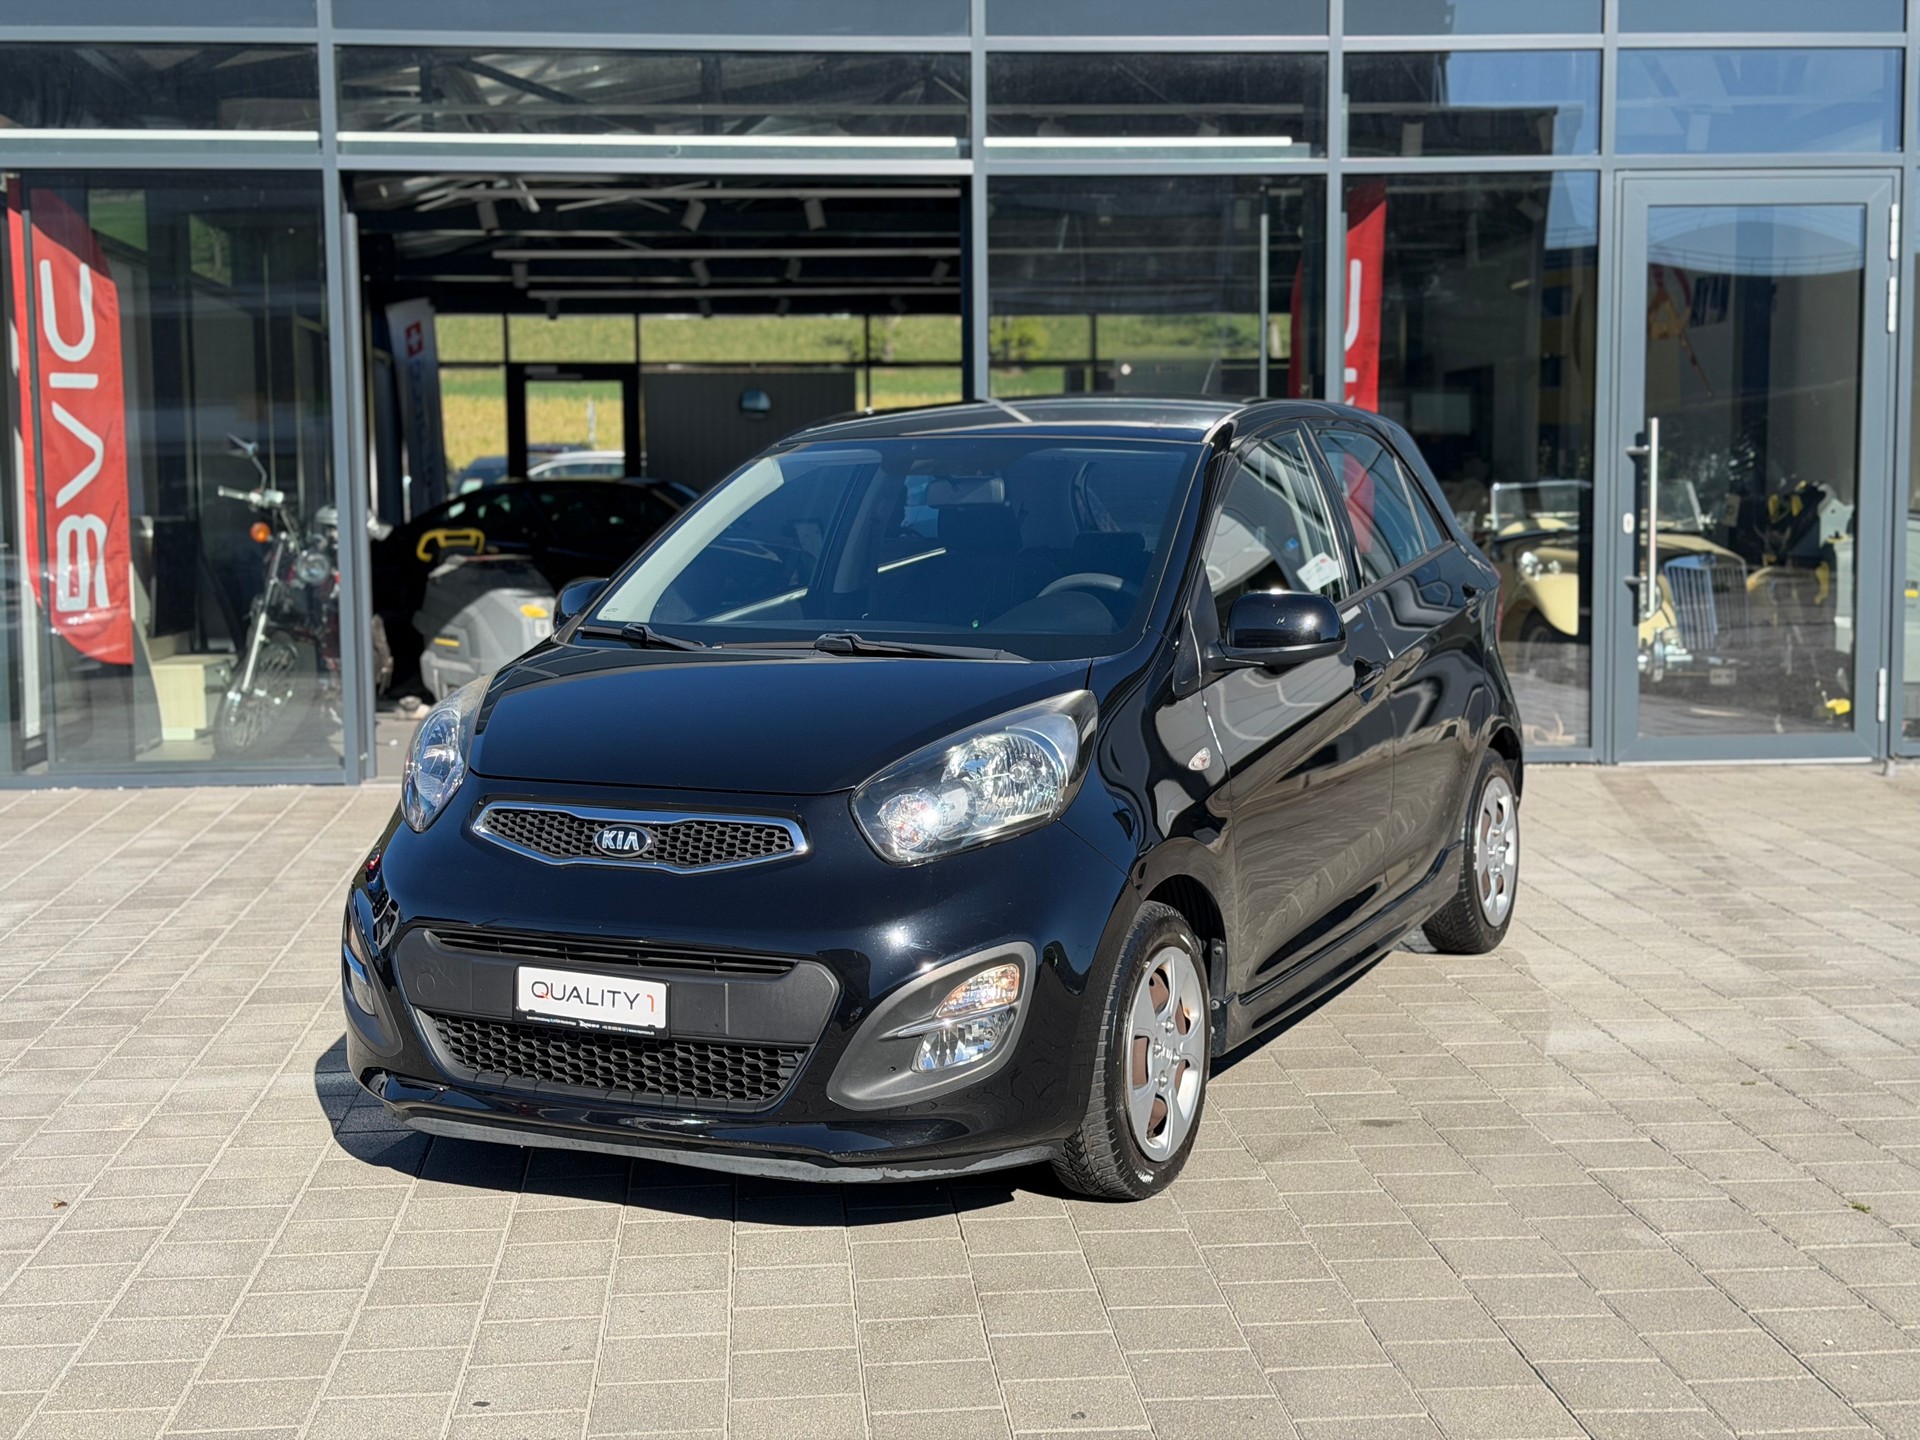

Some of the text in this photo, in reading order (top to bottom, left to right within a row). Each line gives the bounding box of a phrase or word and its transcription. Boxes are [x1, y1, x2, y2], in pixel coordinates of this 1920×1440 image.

[602, 830, 640, 850] KIA
[531, 981, 655, 1012] QUALITY 1
